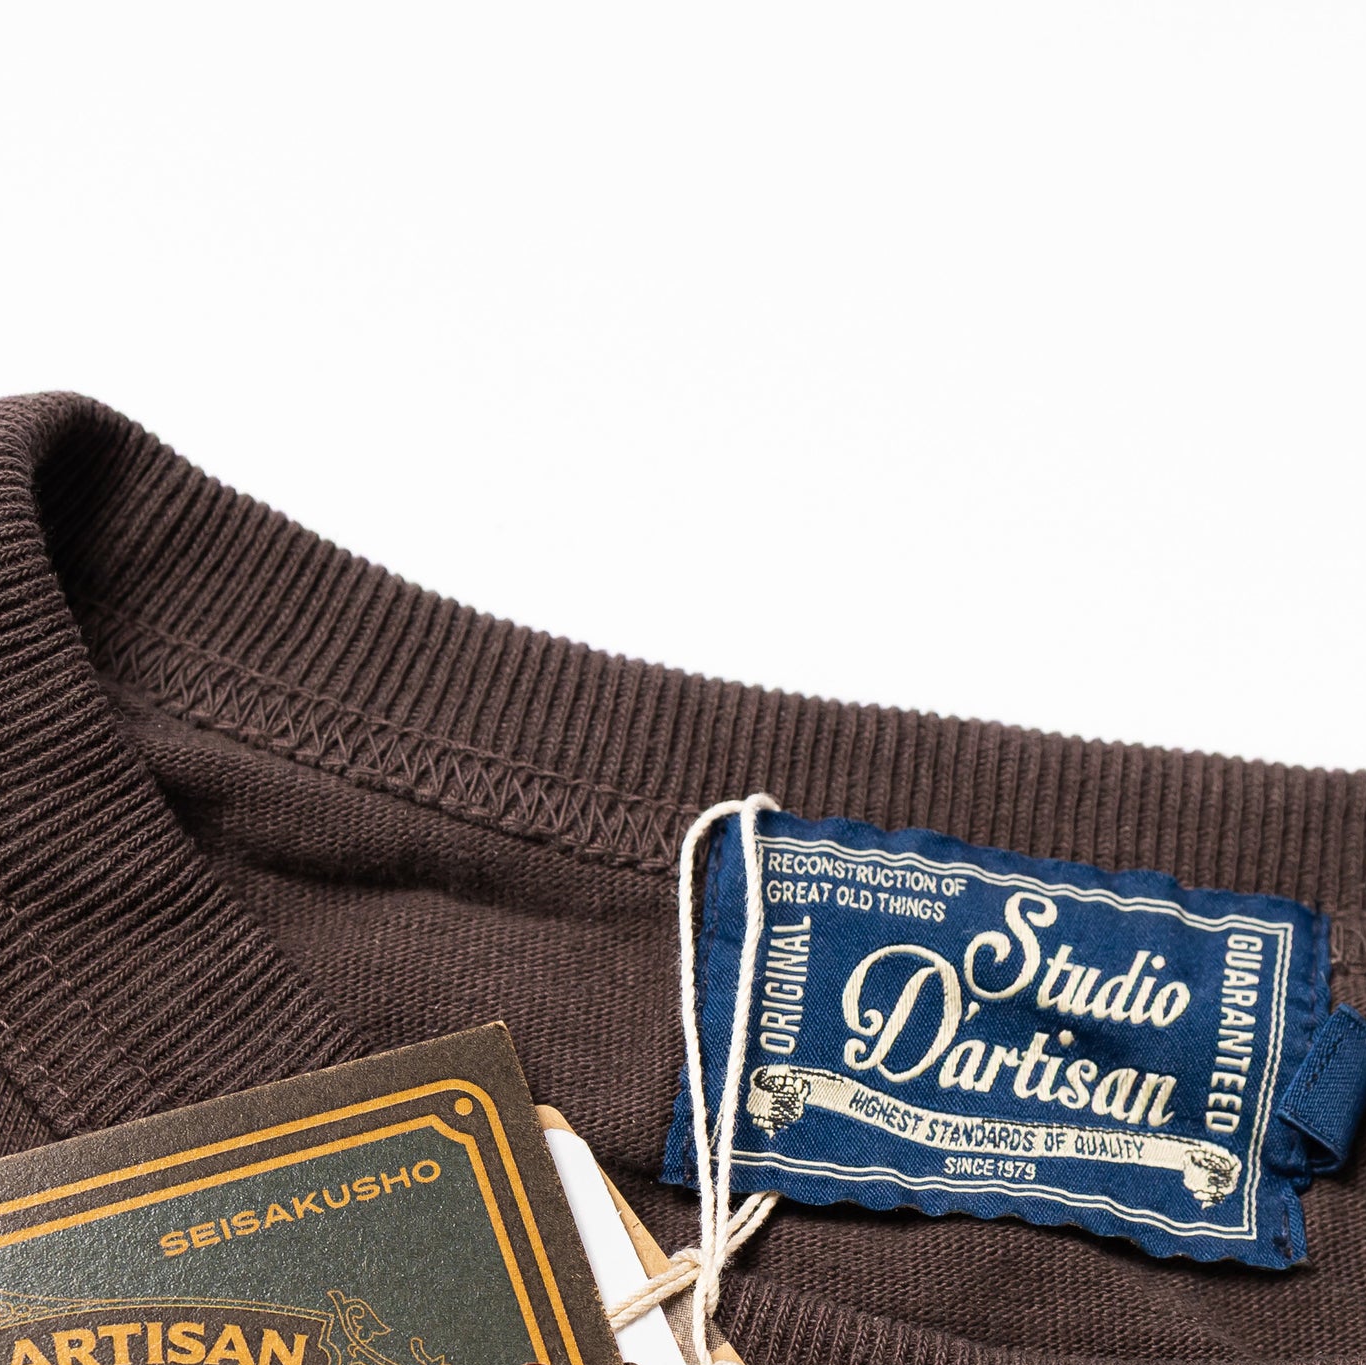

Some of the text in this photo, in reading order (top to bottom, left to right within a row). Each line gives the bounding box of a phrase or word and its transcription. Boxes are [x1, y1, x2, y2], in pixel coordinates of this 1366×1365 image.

[766, 879, 946, 923] GREAT OLD THINGS
[768, 852, 968, 897] RECONSTRUCTION OF
[760, 915, 811, 1055] ORIGINAL
[964, 891, 1191, 1028] Studio
[1205, 932, 1264, 1134] GUARANTEED
[849, 1088, 1145, 1160] HIGHEST STANDARDS OF QUALITY
[160, 1159, 442, 1258] SEISAKUSHO
[944, 1156, 1037, 1180] SINCE 1979
